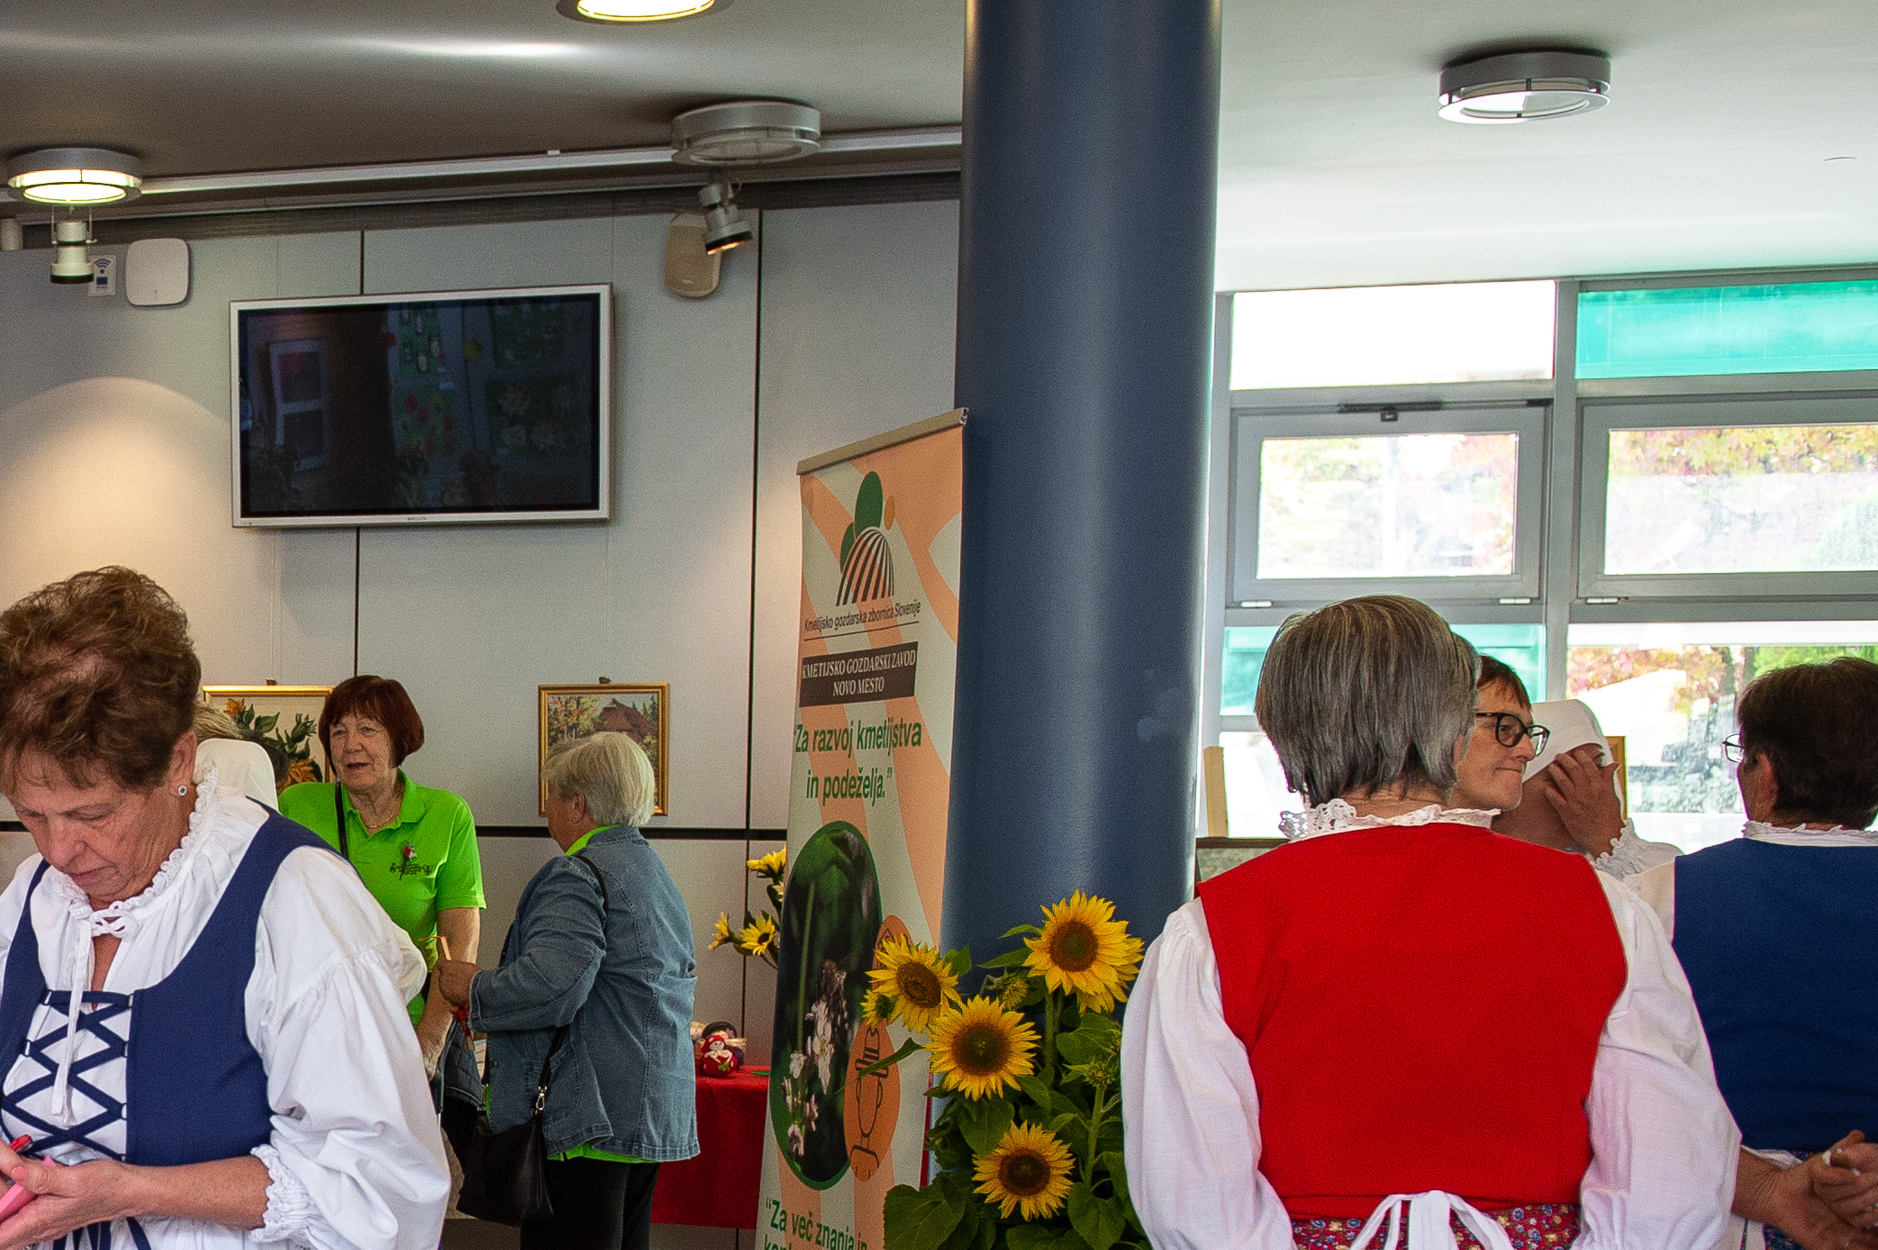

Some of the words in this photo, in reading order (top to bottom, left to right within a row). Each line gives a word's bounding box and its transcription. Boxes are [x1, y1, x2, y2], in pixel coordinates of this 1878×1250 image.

[804, 616, 833, 632] Kmetijsko
[834, 610, 867, 631] gozdarska
[867, 606, 894, 623] zbornica
[894, 599, 921, 618] Slovenije
[802, 660, 846, 679] KMETIJSKO
[846, 653, 891, 674] GOZDARSKI
[891, 649, 916, 668] ZAVOD
[833, 680, 857, 697] NOVO
[857, 677, 885, 694] MESTO
[812, 720, 854, 758] razvoj
[856, 717, 922, 757] kmetijstva
[806, 769, 819, 799] in
[791, 1211, 813, 1242] več
